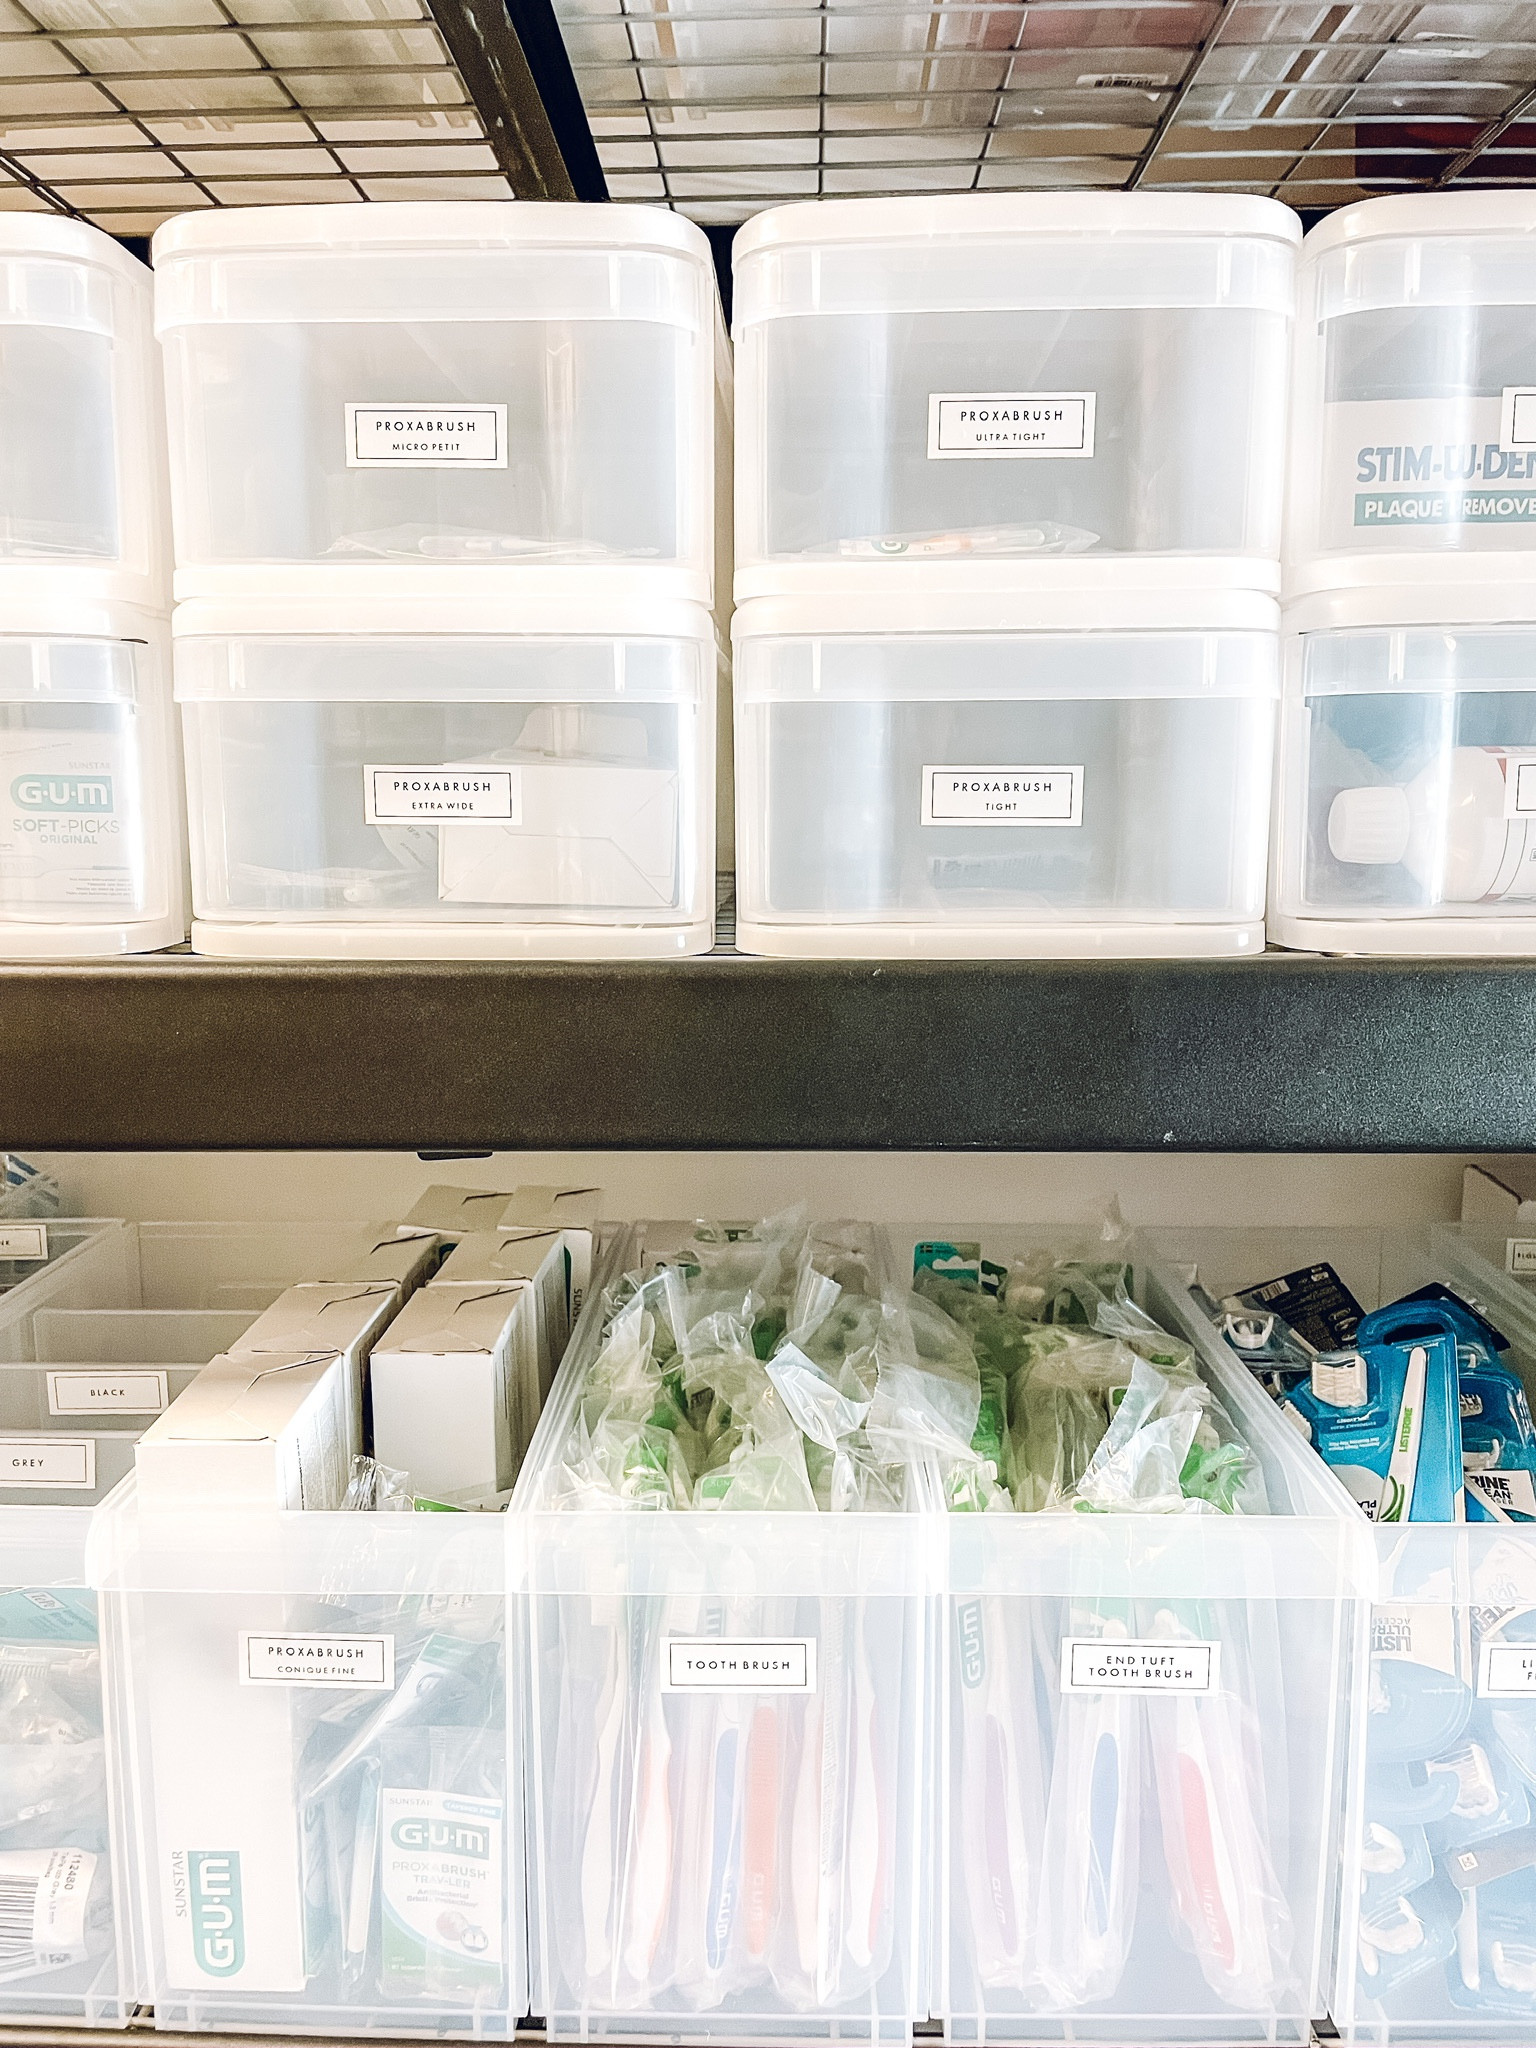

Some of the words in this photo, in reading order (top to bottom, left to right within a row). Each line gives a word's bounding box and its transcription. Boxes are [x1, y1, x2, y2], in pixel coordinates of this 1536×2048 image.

[960, 410, 1063, 421] PROXABRUSH
[376, 421, 476, 431] PROXABRUSH
[976, 433, 1009, 441] ULTRA
[1013, 433, 1046, 441] TIGHT
[392, 443, 428, 451] MICRO
[432, 443, 460, 451] PETIT
[1364, 500, 1444, 519] PLAQUE
[394, 782, 491, 791] PROXABRUSH
[953, 783, 1052, 792] PROXABRUSH
[412, 802, 443, 810] EXTRA
[446, 802, 474, 810] WIDE
[13, 819, 120, 833] SOFT-PICKS
[40, 834, 98, 844] ORIGINAL
[90, 1389, 126, 1397] BLACK
[12, 1458, 44, 1467] GREY
[268, 1646, 364, 1658] PROXABRUSH
[687, 1660, 737, 1670] TOOTH
[743, 1661, 790, 1670] BRUSH
[1106, 1655, 1136, 1665] END
[1141, 1656, 1175, 1666] TUFT
[277, 1666, 328, 1674] CONIQUE
[331, 1667, 356, 1675] FINE
[1089, 1667, 1139, 1677] TOOTH
[1145, 1669, 1192, 1679] BRUSH
[172, 1851, 187, 1917] SUNSTAR
